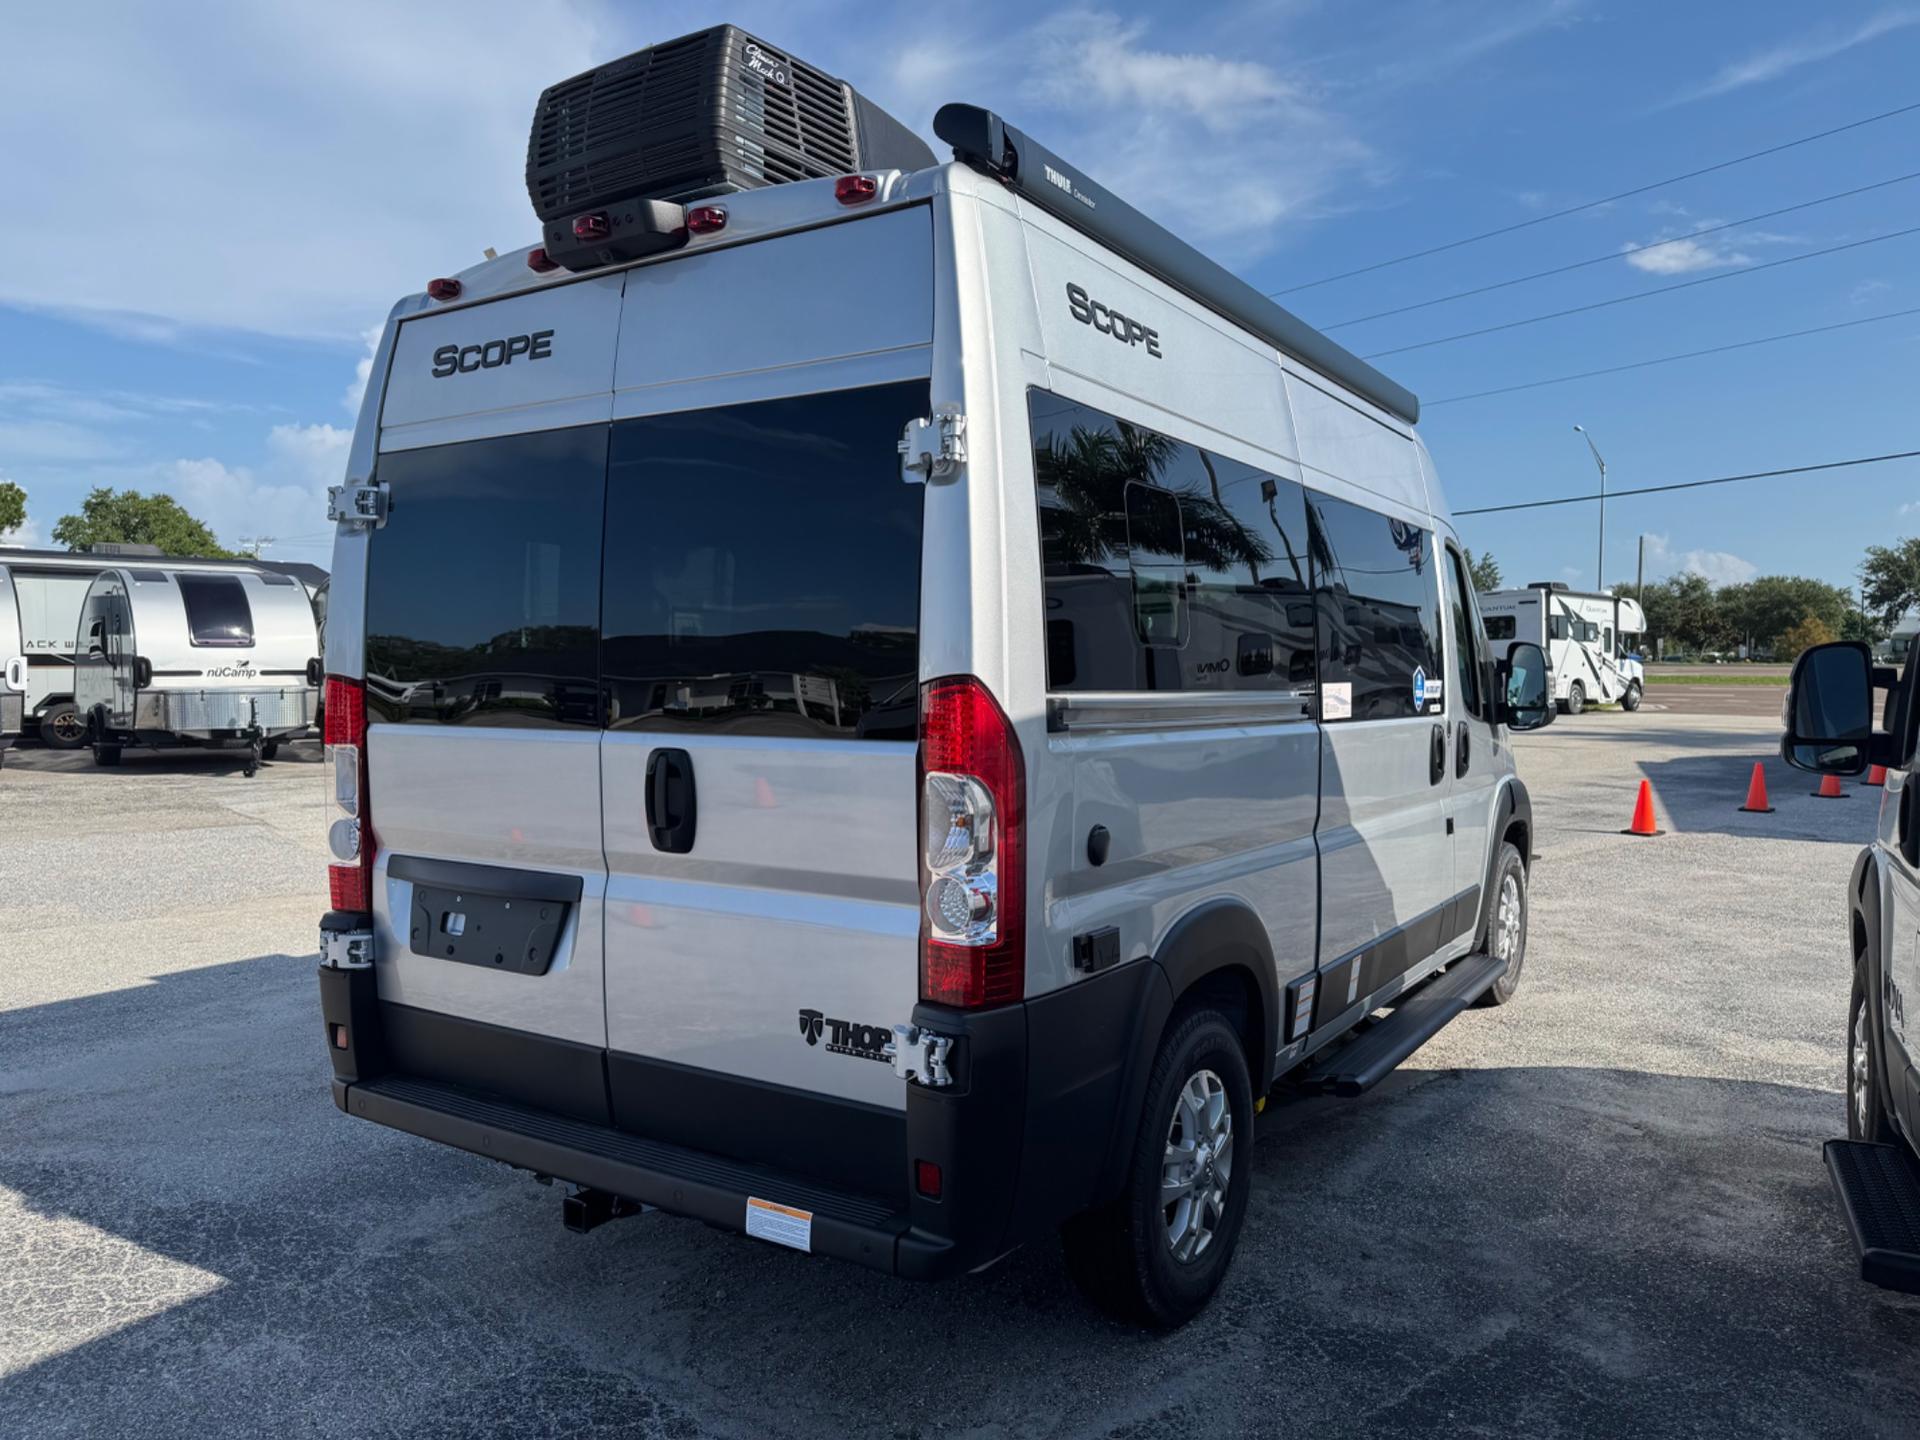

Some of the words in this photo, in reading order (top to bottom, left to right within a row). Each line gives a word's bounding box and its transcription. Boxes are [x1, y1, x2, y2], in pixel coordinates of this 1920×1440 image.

[776, 72, 784, 84] Q
[1043, 163, 1071, 194] THULE
[1066, 282, 1162, 359] SCOPE
[431, 329, 555, 378] SCOPE
